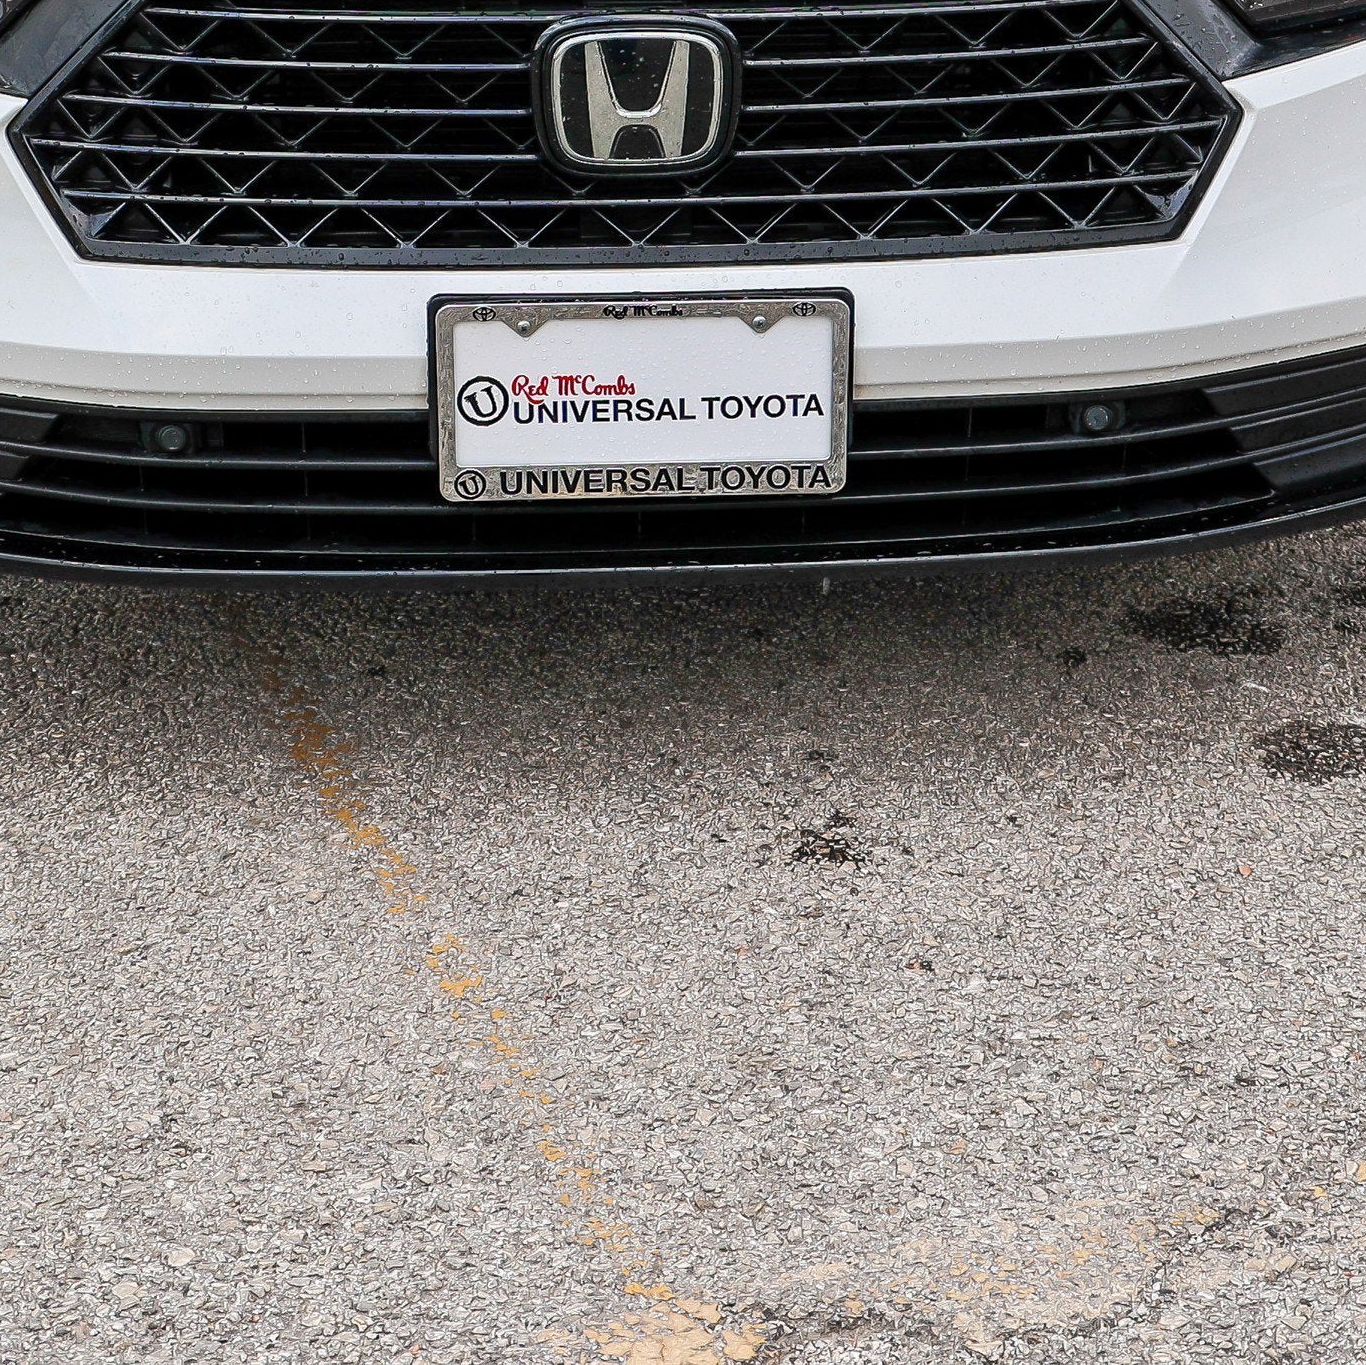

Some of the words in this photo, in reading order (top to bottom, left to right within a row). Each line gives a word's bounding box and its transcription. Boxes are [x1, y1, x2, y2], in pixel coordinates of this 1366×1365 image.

[511, 374, 549, 405] Red
[552, 374, 636, 397] McCombs
[513, 397, 696, 426] UNIVERSAL
[701, 393, 825, 421] TOYOTA
[500, 467, 698, 496] UNIVERSAL
[700, 465, 833, 492] TOYOTA
